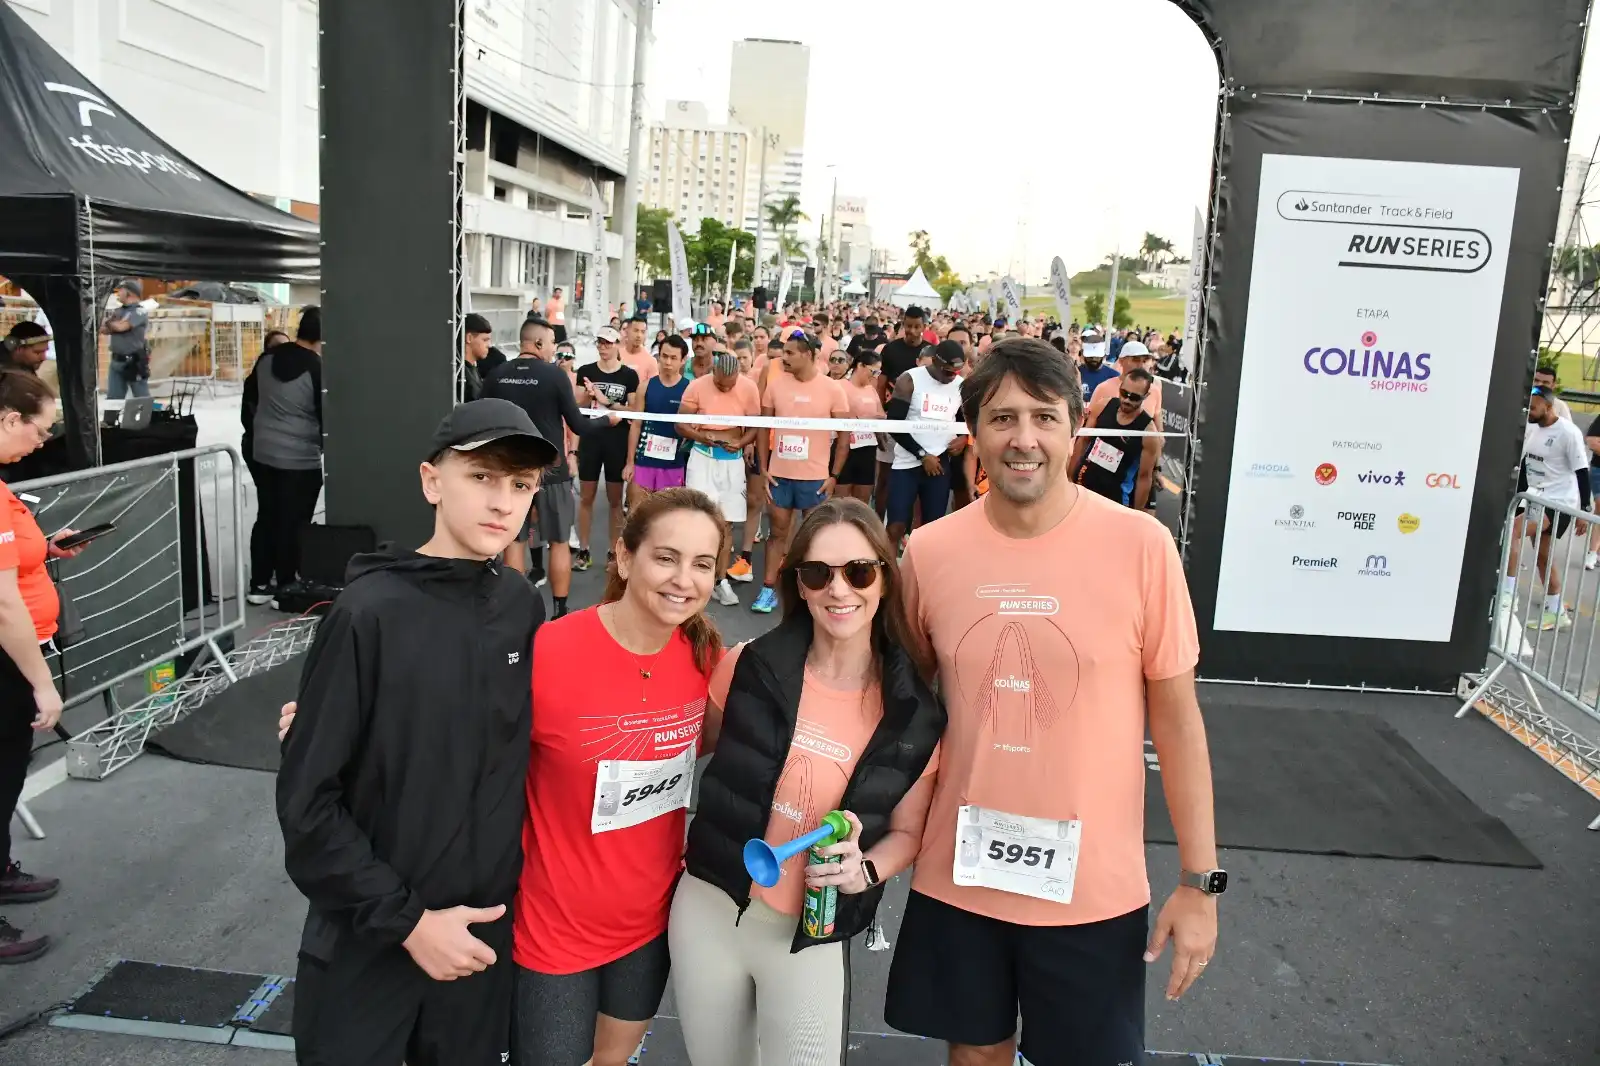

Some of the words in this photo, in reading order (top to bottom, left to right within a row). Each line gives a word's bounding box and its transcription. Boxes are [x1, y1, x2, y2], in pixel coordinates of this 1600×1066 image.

[836, 204, 865, 214] OLINAS
[1310, 201, 1373, 215] Santander
[1356, 308, 1390, 320] ETAPA
[1303, 346, 1432, 381] COLINAS
[1370, 380, 1429, 393] SHOPPING
[783, 444, 803, 454] 1450
[1251, 463, 1291, 472] RHODIA
[1358, 470, 1392, 484] vivo
[1425, 473, 1461, 489] GOL
[1337, 511, 1376, 521] POWER
[1274, 519, 1316, 529] ESSENTIAL
[1353, 521, 1375, 530] ADE
[1292, 555, 1338, 568] PremieR
[1357, 568, 1391, 577] minalba
[994, 678, 1030, 689] COLINAS
[621, 773, 683, 807] 5949
[987, 839, 1056, 870] 5951
